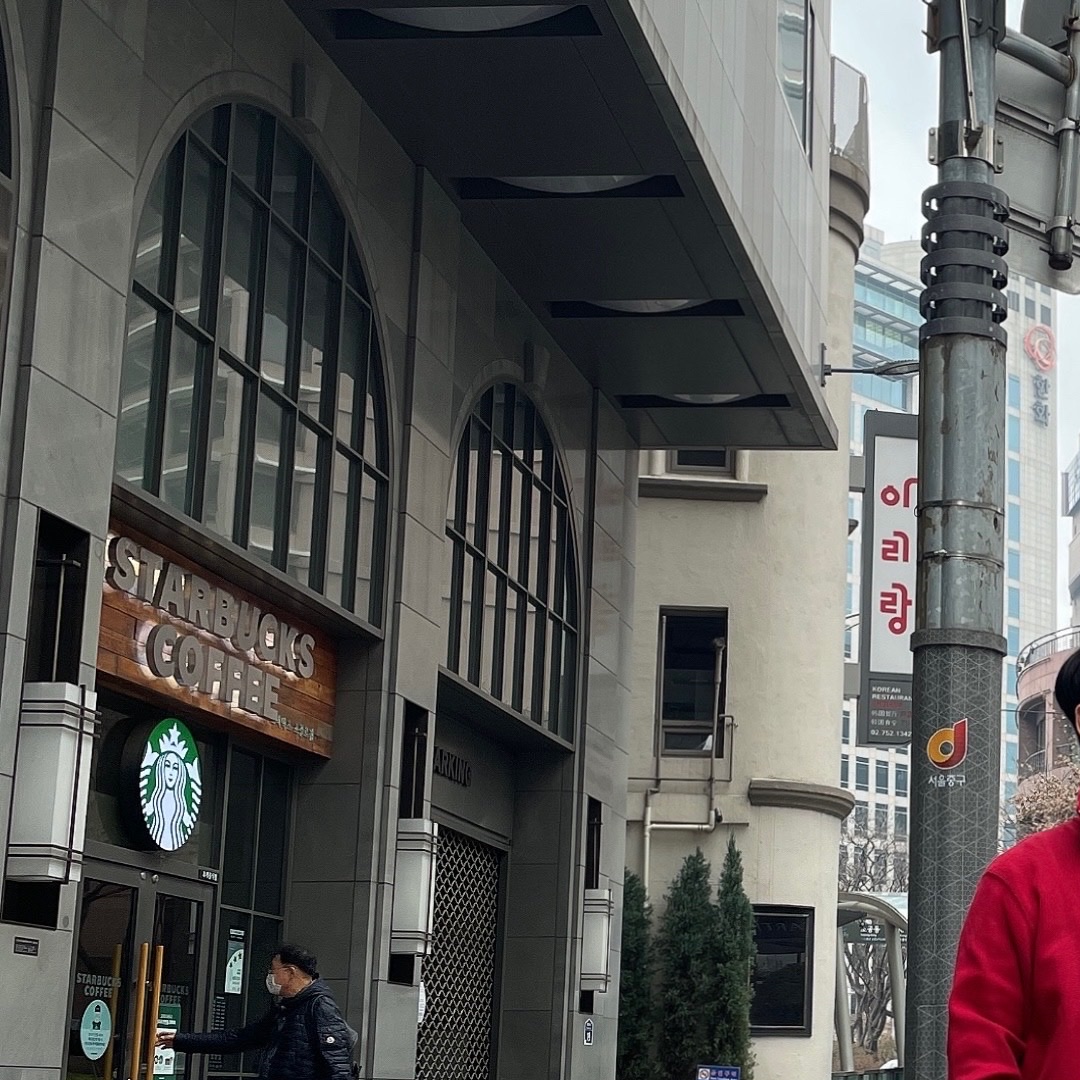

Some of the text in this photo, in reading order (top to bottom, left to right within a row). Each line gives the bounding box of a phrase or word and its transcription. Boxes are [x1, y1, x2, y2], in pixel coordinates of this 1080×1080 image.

[1032, 374, 1050, 429] 한화
[105, 536, 316, 679] STARBUCKS
[146, 624, 281, 721] COFFEE
[434, 746, 471, 787] ARKING
[928, 775, 966, 788] 서울중구
[84, 985, 113, 998] COFFEE
